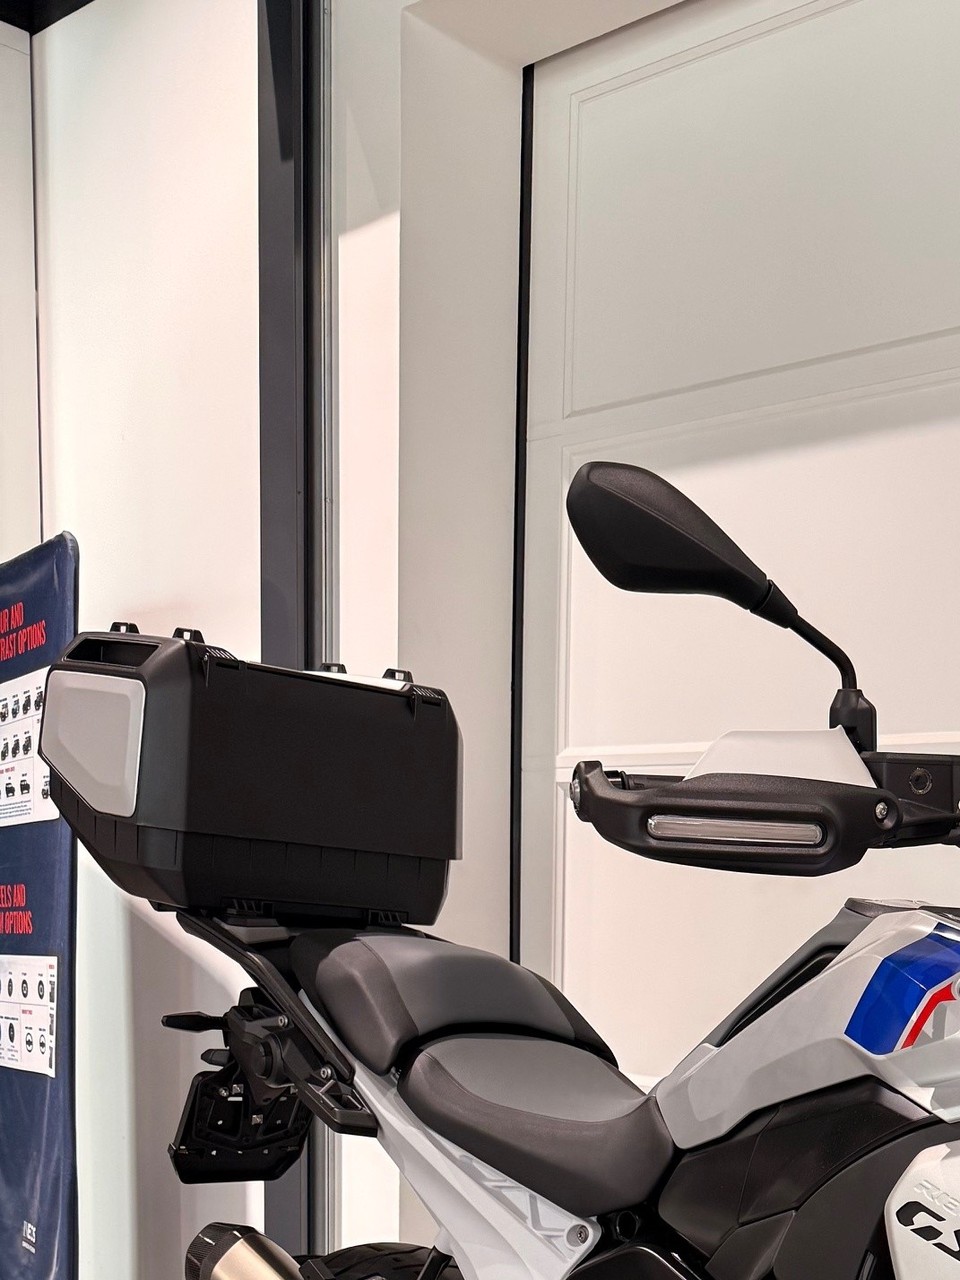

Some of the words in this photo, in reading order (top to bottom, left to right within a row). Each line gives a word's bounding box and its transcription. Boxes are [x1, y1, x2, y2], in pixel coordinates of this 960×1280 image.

[11, 602, 24, 630] AND
[0, 633, 16, 661] RAST
[18, 620, 46, 655] OPTIONS
[0, 885, 12, 908] ELS
[13, 884, 26, 907] AND
[5, 911, 33, 934] OPTIONS
